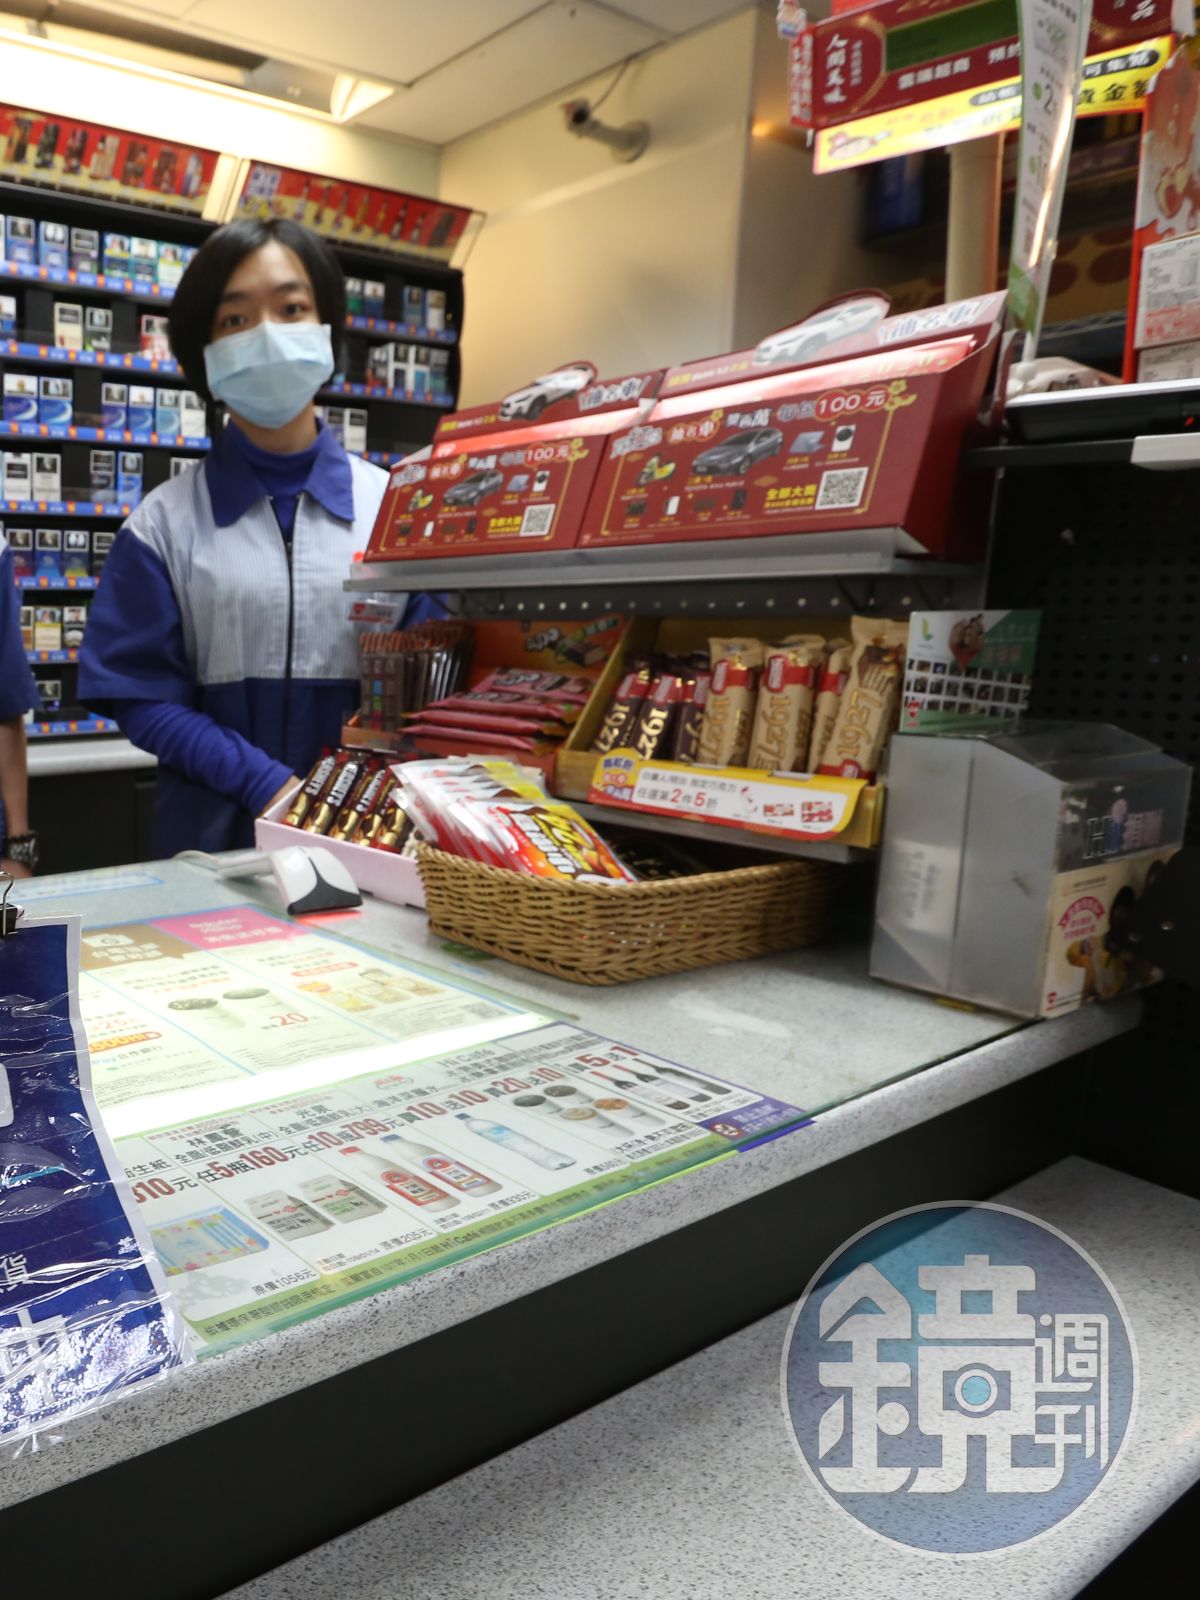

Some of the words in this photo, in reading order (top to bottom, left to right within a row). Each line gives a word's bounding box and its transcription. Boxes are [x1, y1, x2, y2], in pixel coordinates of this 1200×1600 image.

[758, 695, 791, 765] 1927
[188, 1140, 310, 1185] 任5瓶160元
[249, 1266, 319, 1298] 原價1056元
